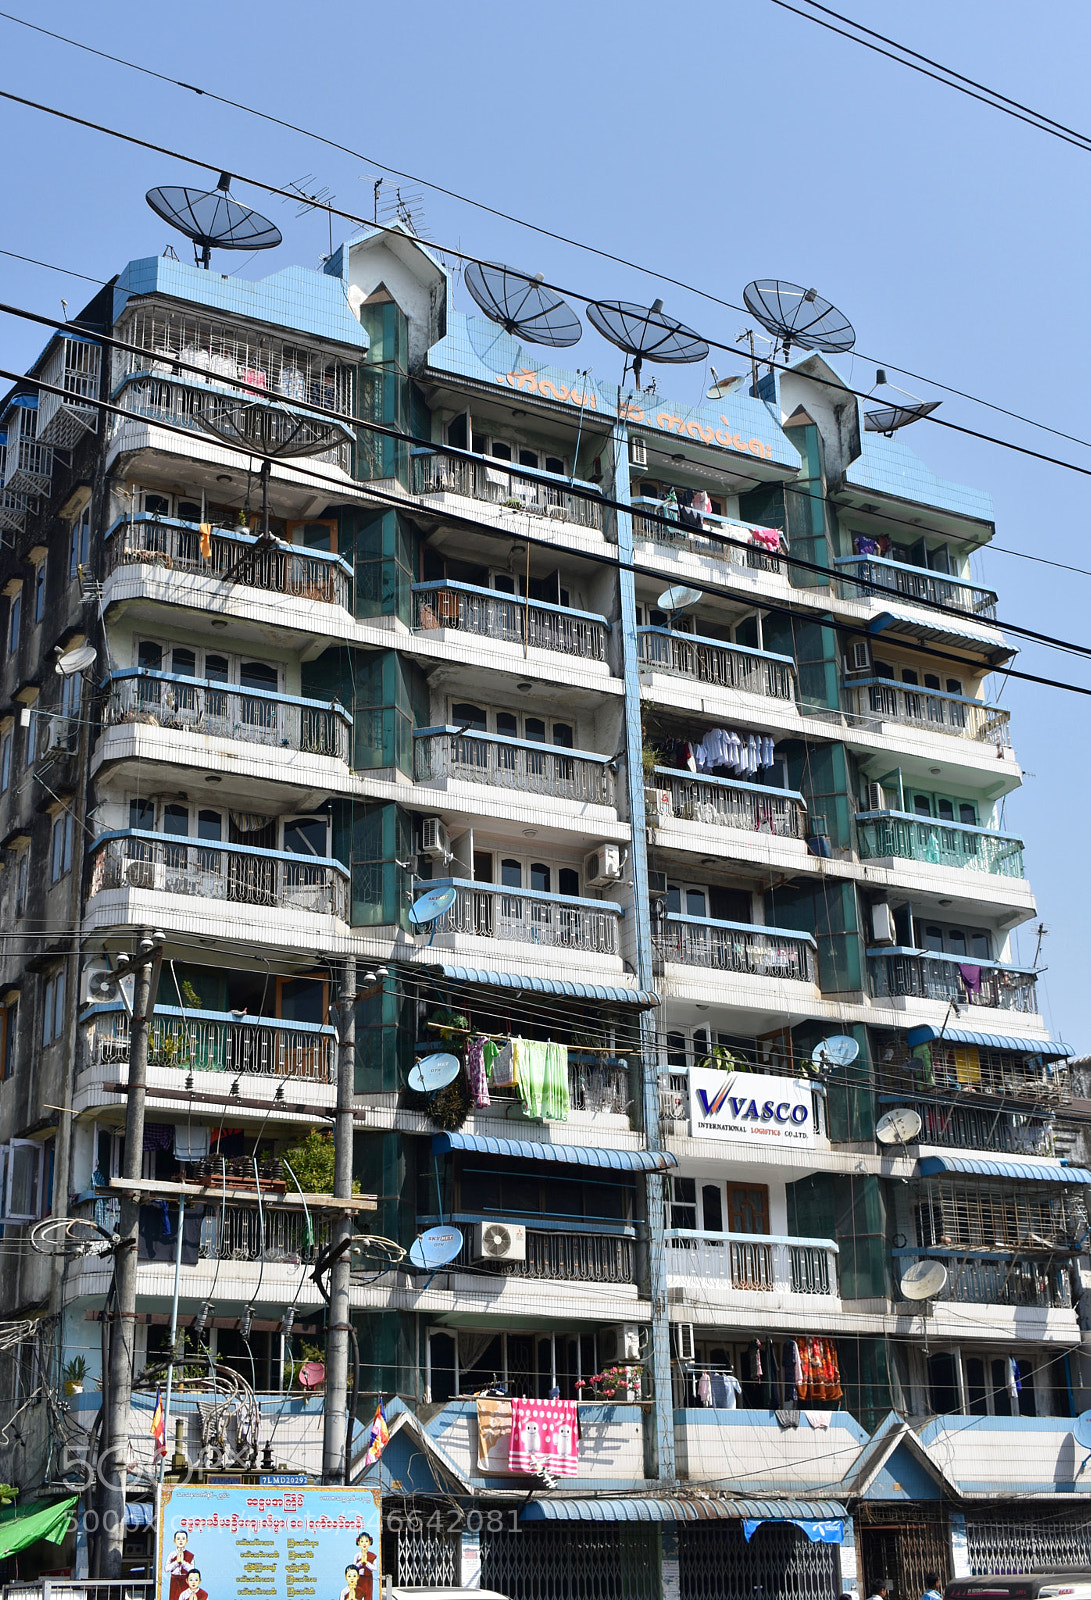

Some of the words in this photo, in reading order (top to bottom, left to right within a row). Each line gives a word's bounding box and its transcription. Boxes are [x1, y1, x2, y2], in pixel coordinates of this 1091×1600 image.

[728, 1096, 809, 1124] VASCO
[697, 1121, 747, 1133] INTERNATIONAL
[750, 1127, 781, 1137] LOGISTICS
[262, 1476, 308, 1484] 7LMD20292
